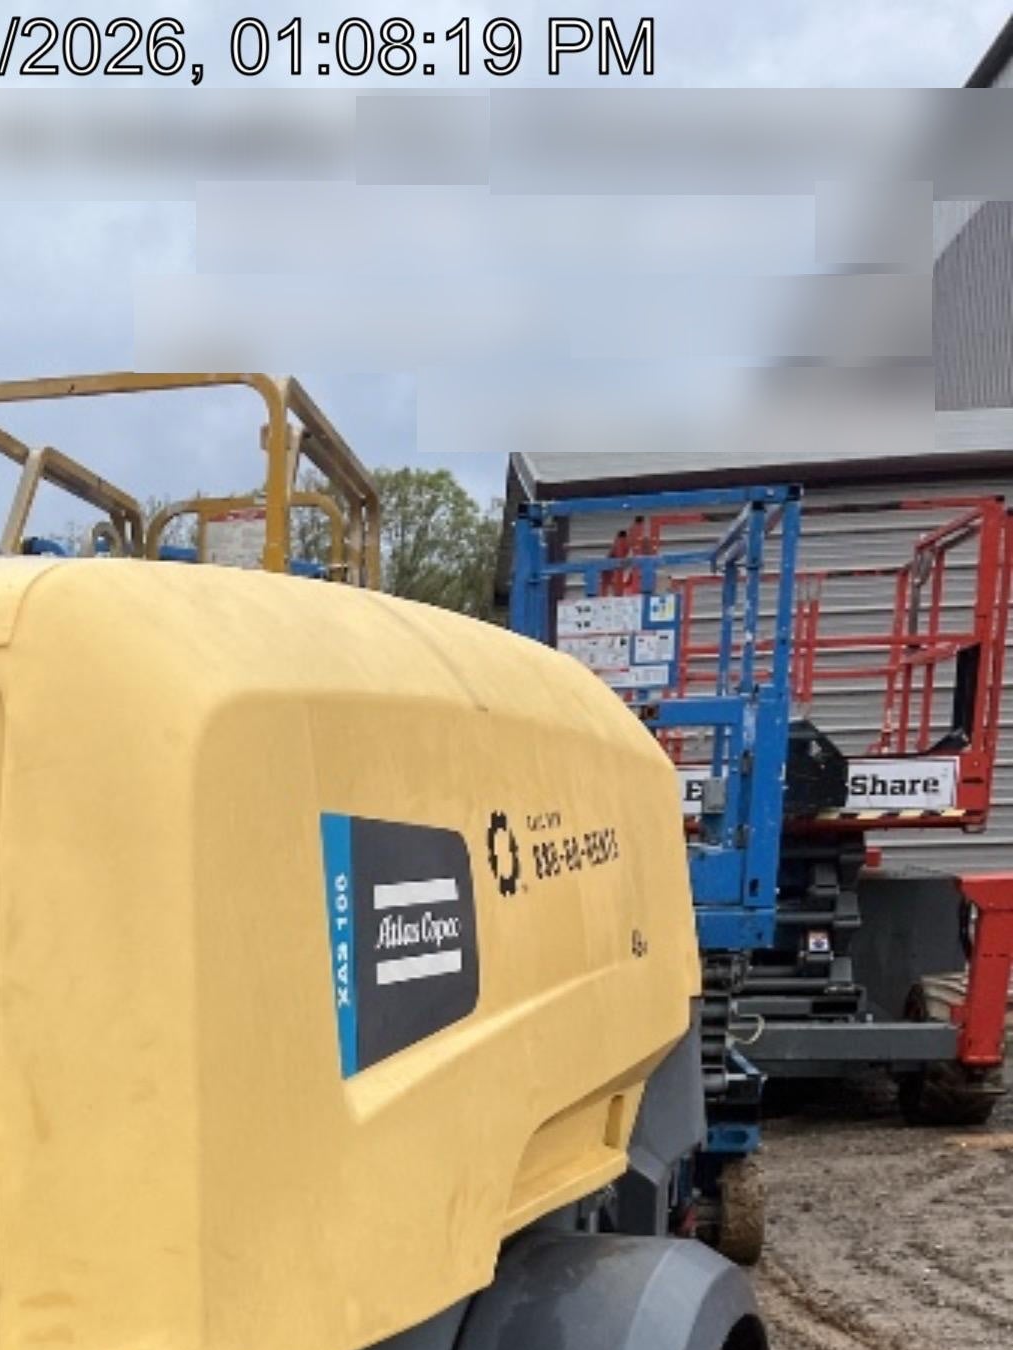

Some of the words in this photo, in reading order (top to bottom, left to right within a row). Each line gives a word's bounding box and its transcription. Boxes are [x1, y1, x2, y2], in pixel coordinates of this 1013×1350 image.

[684, 779, 704, 801] E
[849, 774, 939, 797] Share
[375, 914, 420, 949] Atlas
[422, 911, 462, 946] Copco
[337, 943, 350, 1007] XAS
